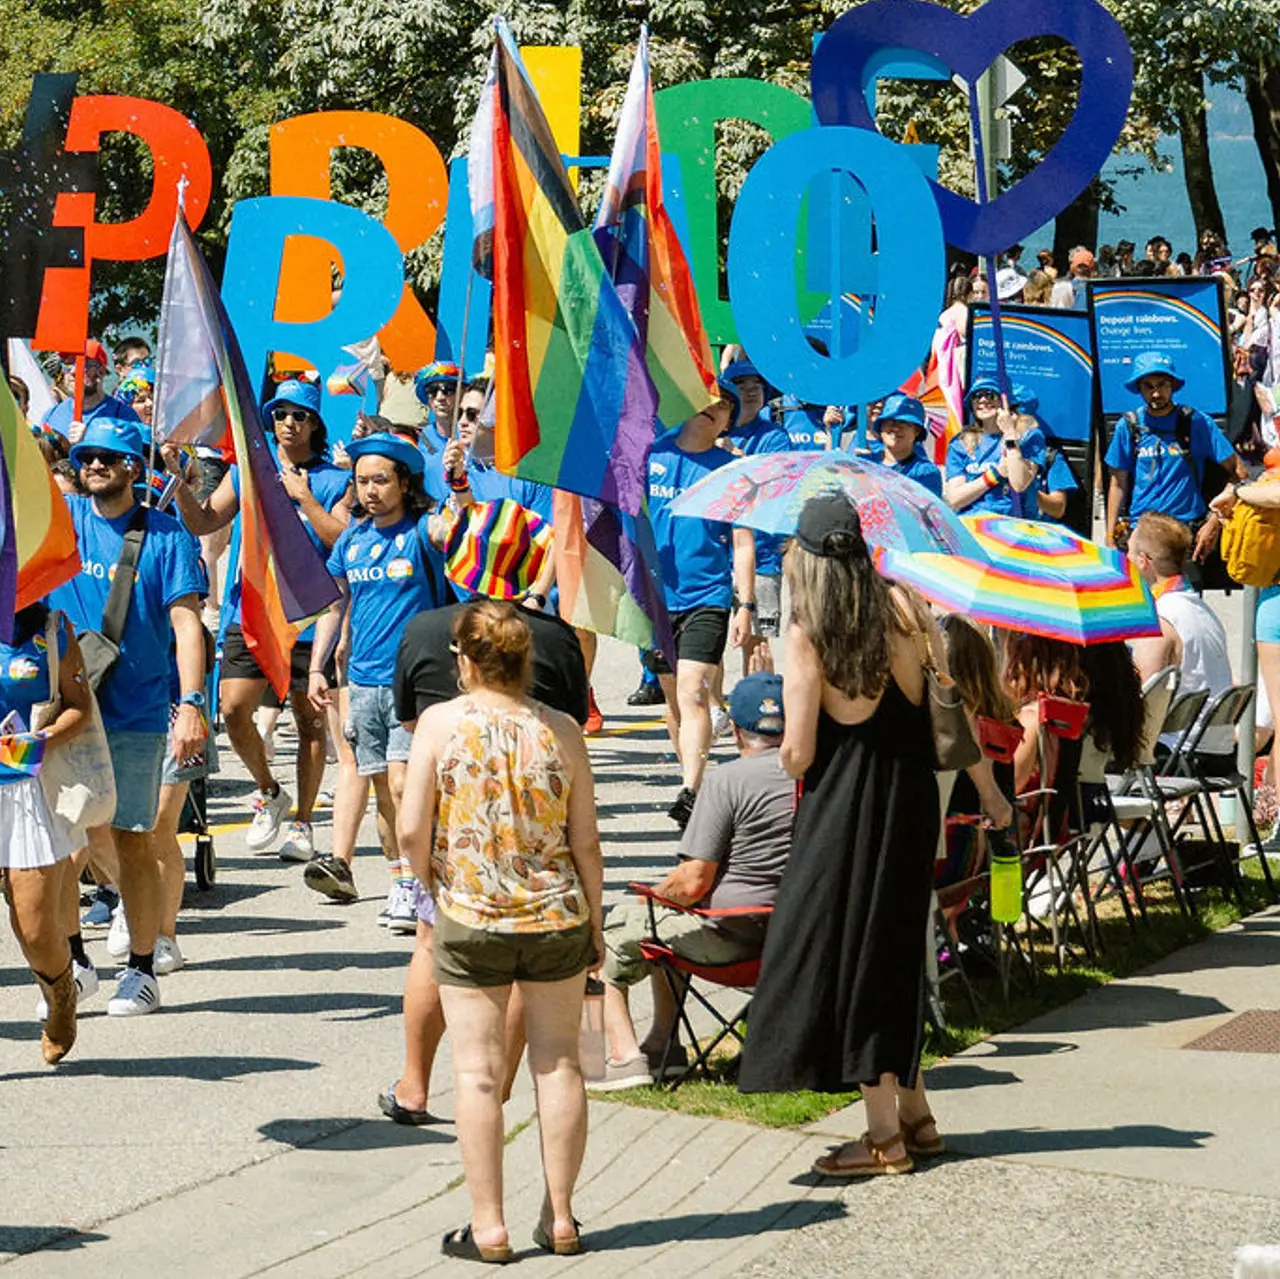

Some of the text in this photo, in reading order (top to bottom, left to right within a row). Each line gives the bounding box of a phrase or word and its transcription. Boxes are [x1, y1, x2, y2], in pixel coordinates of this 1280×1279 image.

[1100, 314, 1179, 325] Deposit rainbows.
[1100, 326, 1131, 336] Change
[978, 338, 1054, 353] Depit rainbows.
[788, 432, 811, 444] MO
[1138, 445, 1165, 458] MO
[81, 560, 105, 580] MO
